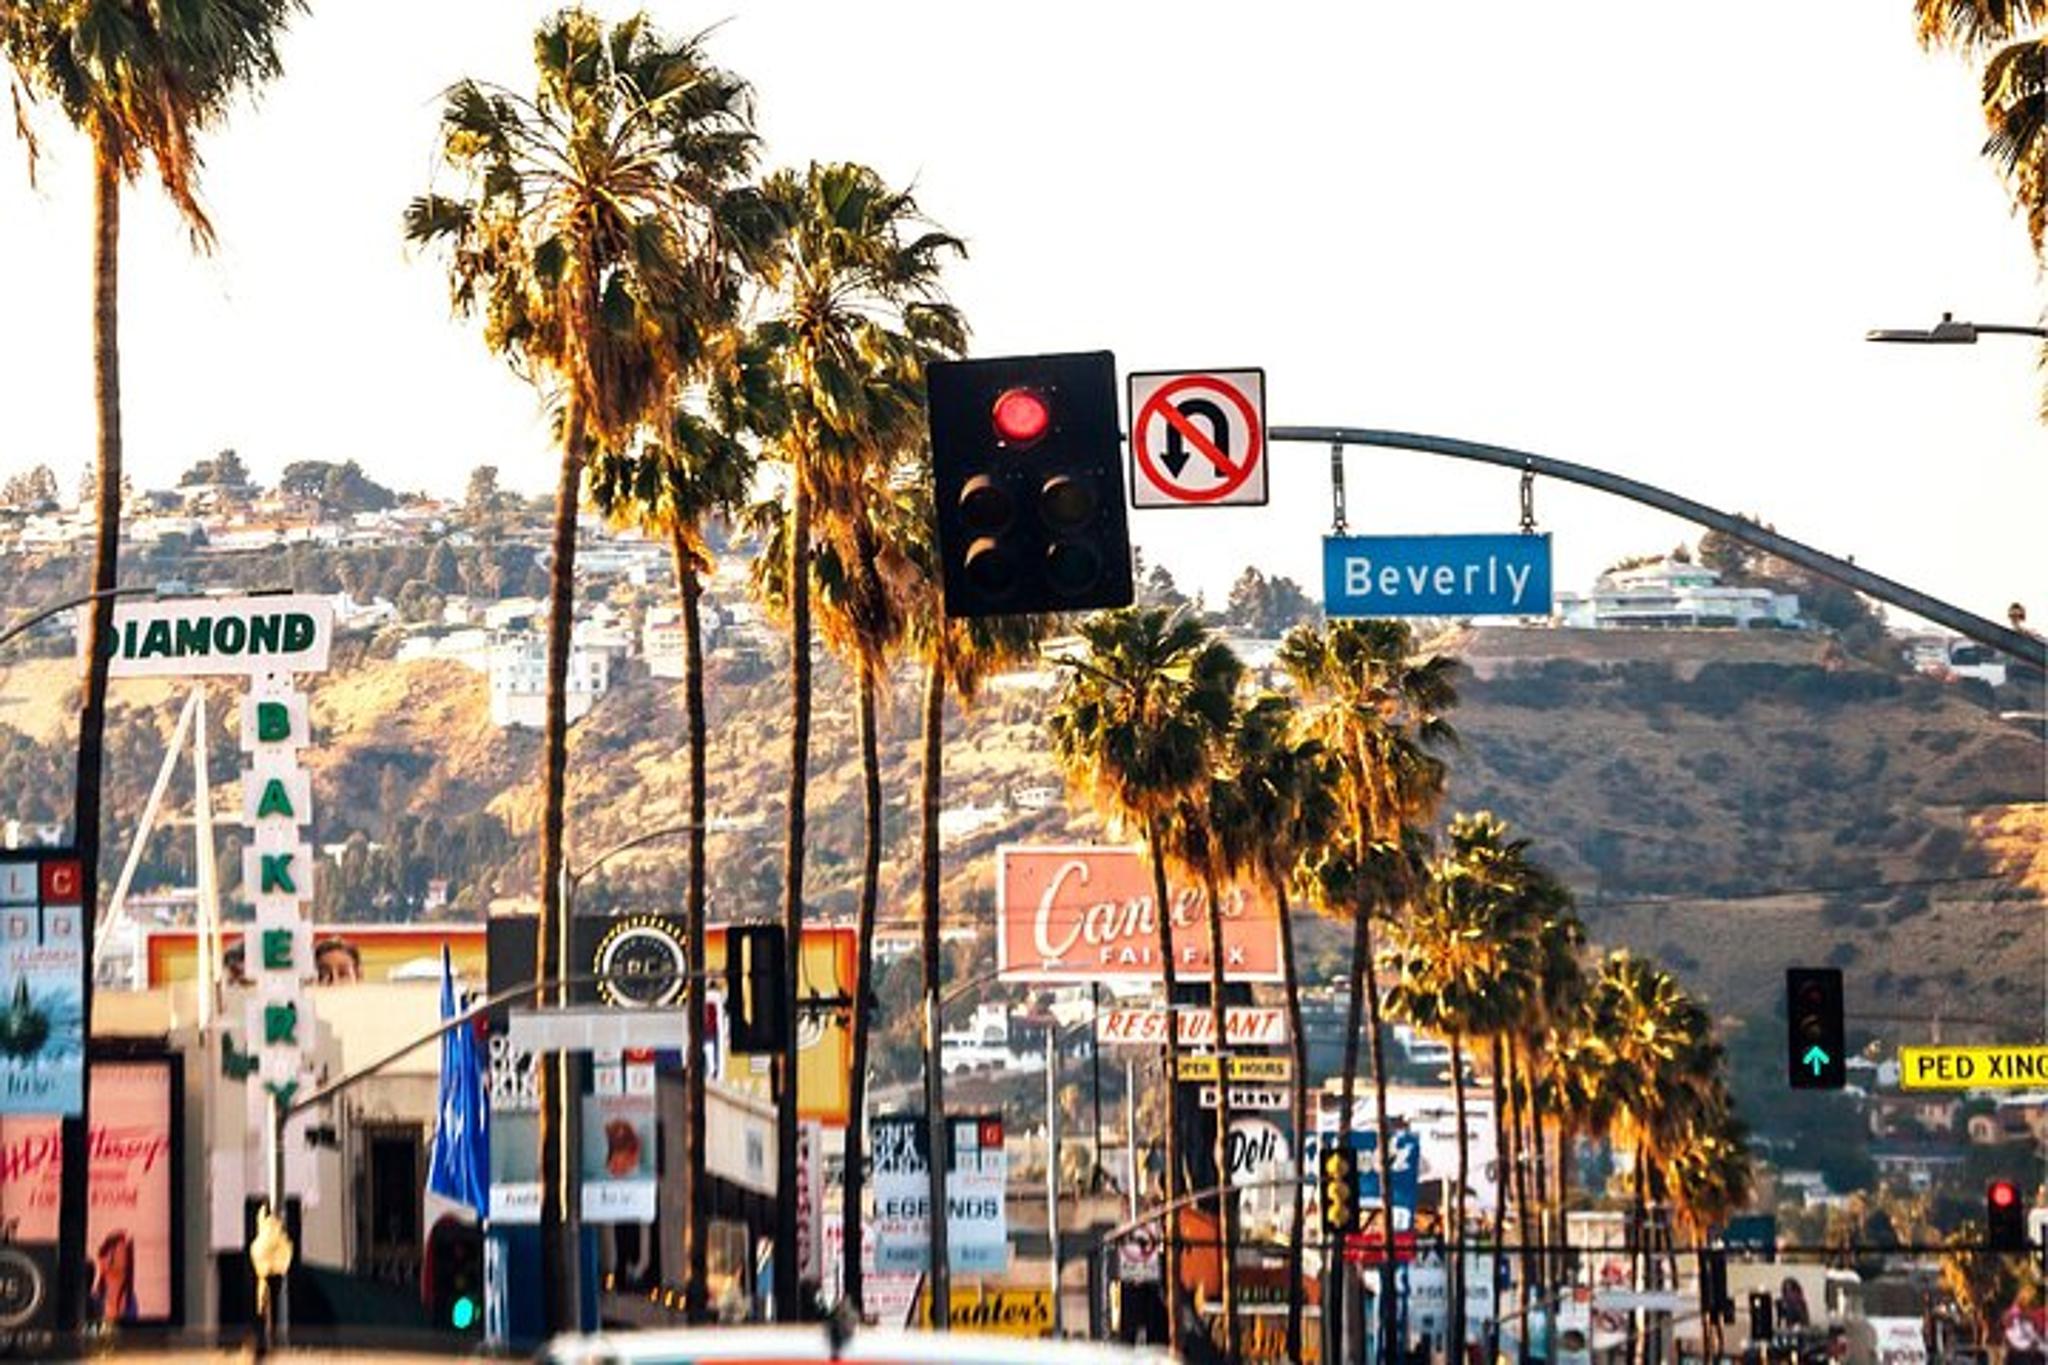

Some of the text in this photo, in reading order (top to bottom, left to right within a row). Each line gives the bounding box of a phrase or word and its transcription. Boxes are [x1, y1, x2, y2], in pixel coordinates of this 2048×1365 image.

[1345, 555, 1531, 605] Beverly
[257, 702, 298, 1112] BAKERY
[1100, 946, 1246, 965] FAIFX
[1919, 1055, 1974, 1080] PED
[1205, 1091, 1281, 1105] BKERY
[1229, 1129, 1277, 1172] Deli
[873, 1197, 998, 1219] LEGENDS
